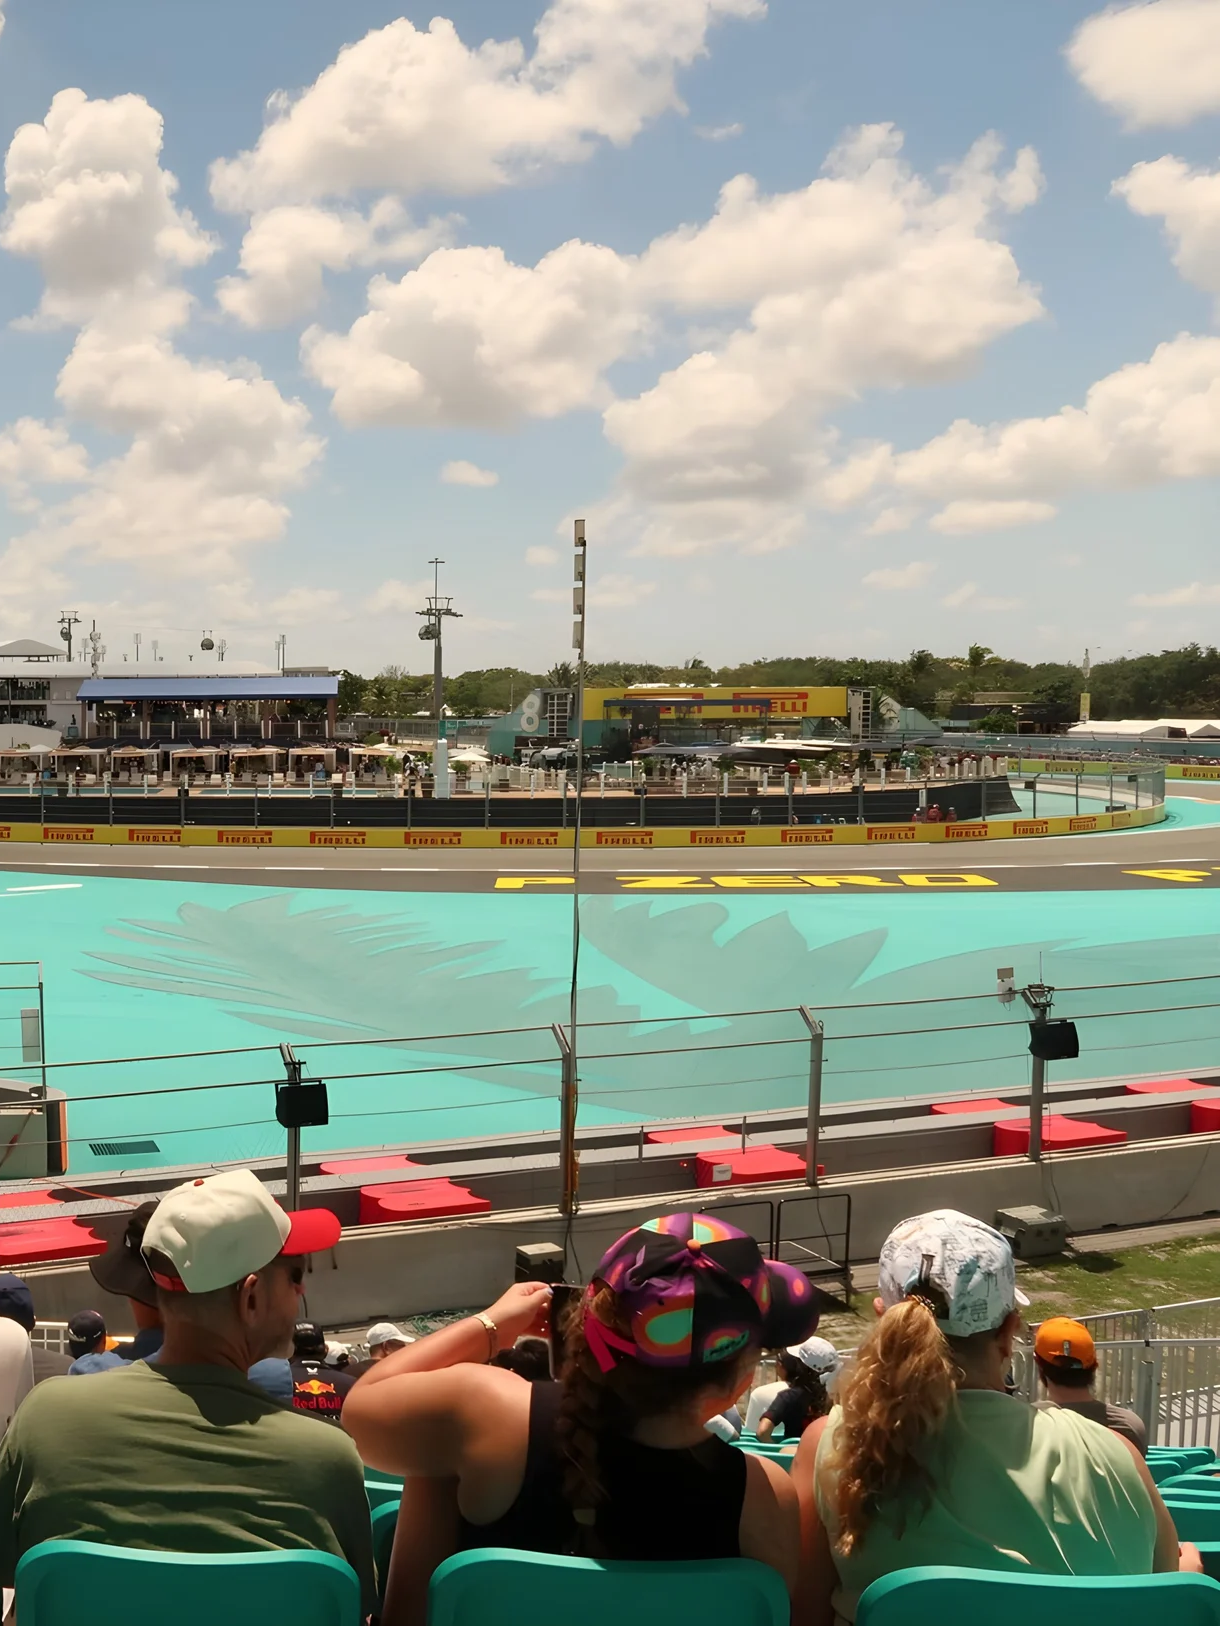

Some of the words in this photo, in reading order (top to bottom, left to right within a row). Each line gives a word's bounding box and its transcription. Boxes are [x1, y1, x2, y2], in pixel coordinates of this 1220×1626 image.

[521, 694, 540, 732] 8
[494, 877, 576, 889] P
[616, 874, 999, 888] ZERO
